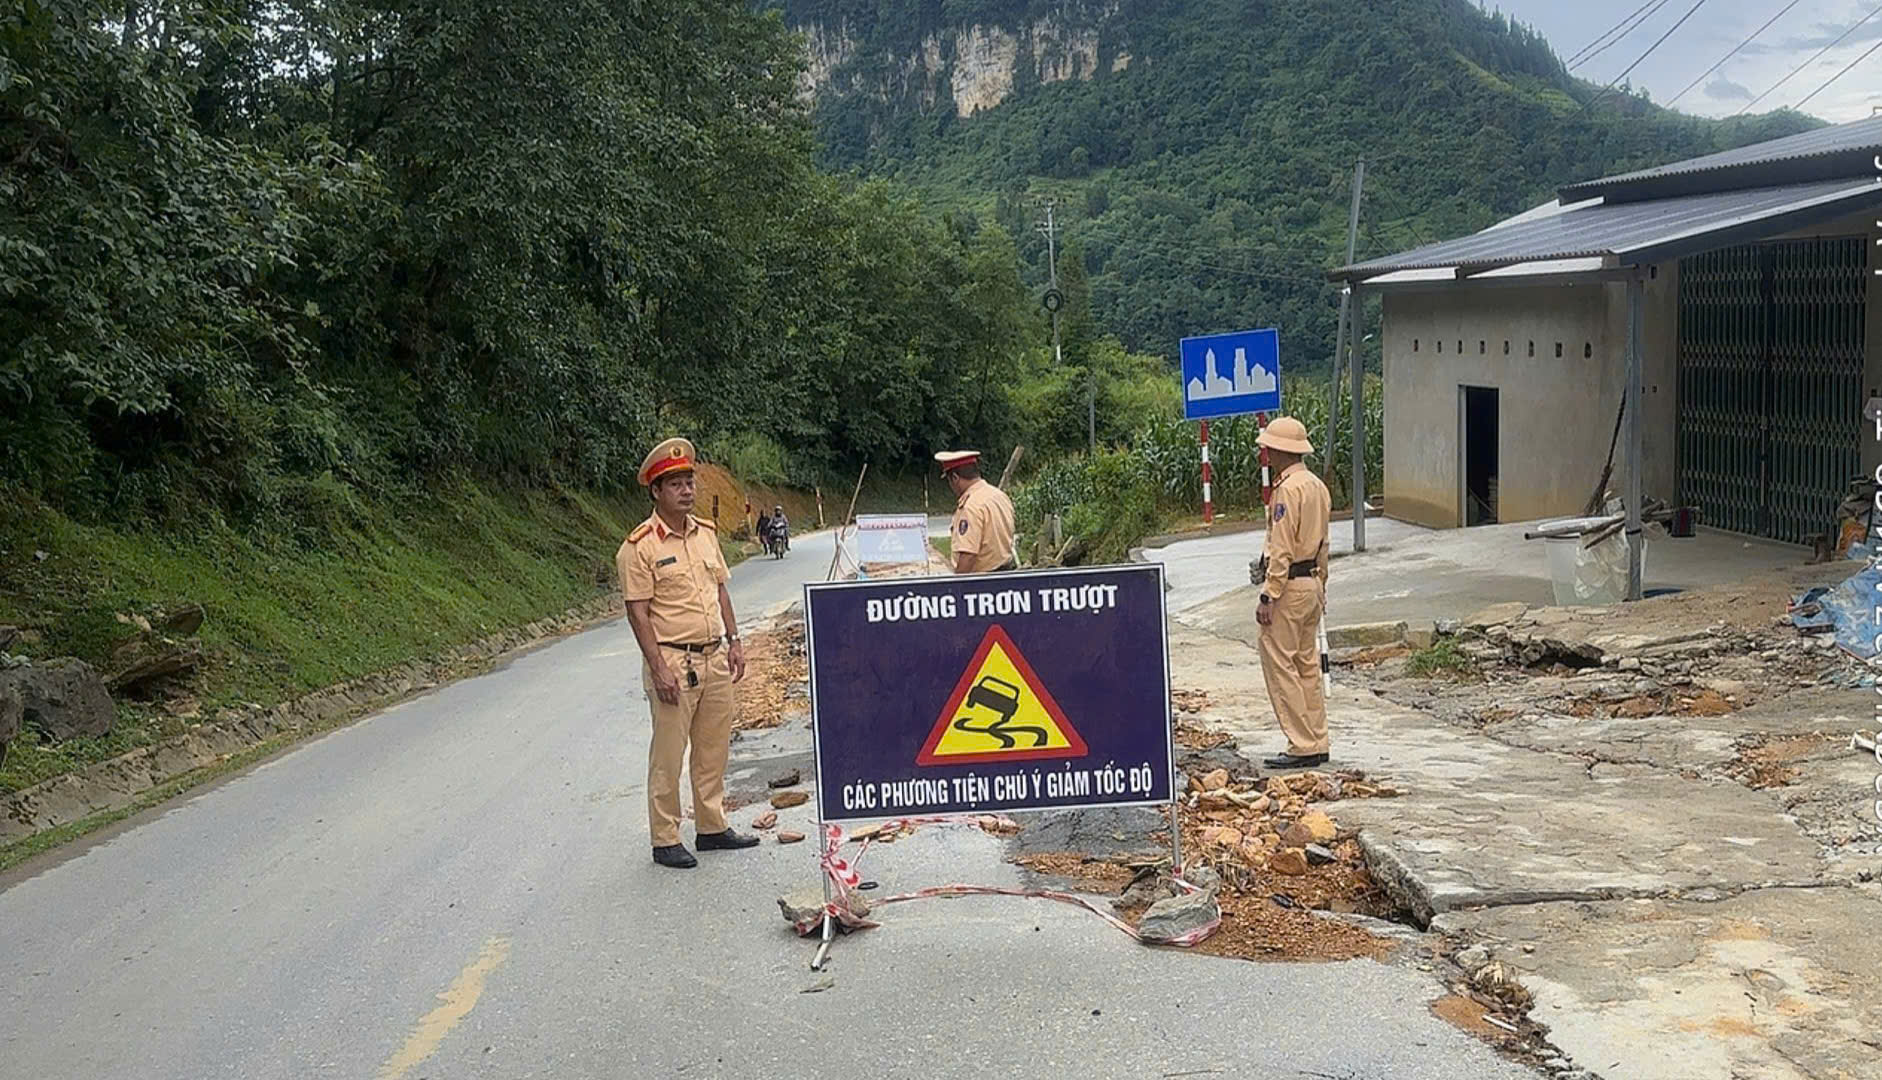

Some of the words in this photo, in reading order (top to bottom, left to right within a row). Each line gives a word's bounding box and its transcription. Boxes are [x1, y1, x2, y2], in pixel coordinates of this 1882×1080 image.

[866, 591, 957, 623] ĐƯỜNG
[964, 589, 1032, 616] TRƠN
[1039, 584, 1118, 614] TRƯỢT
[843, 779, 877, 810] CÁC
[881, 778, 948, 807] PHƯƠNG
[952, 772, 990, 808] TIỆN
[994, 769, 1027, 801] CHÚ
[1031, 768, 1042, 798] Ý
[1047, 762, 1090, 797] GIẢM
[1094, 760, 1126, 795] TỐC
[1130, 761, 1153, 799] ĐỘ
